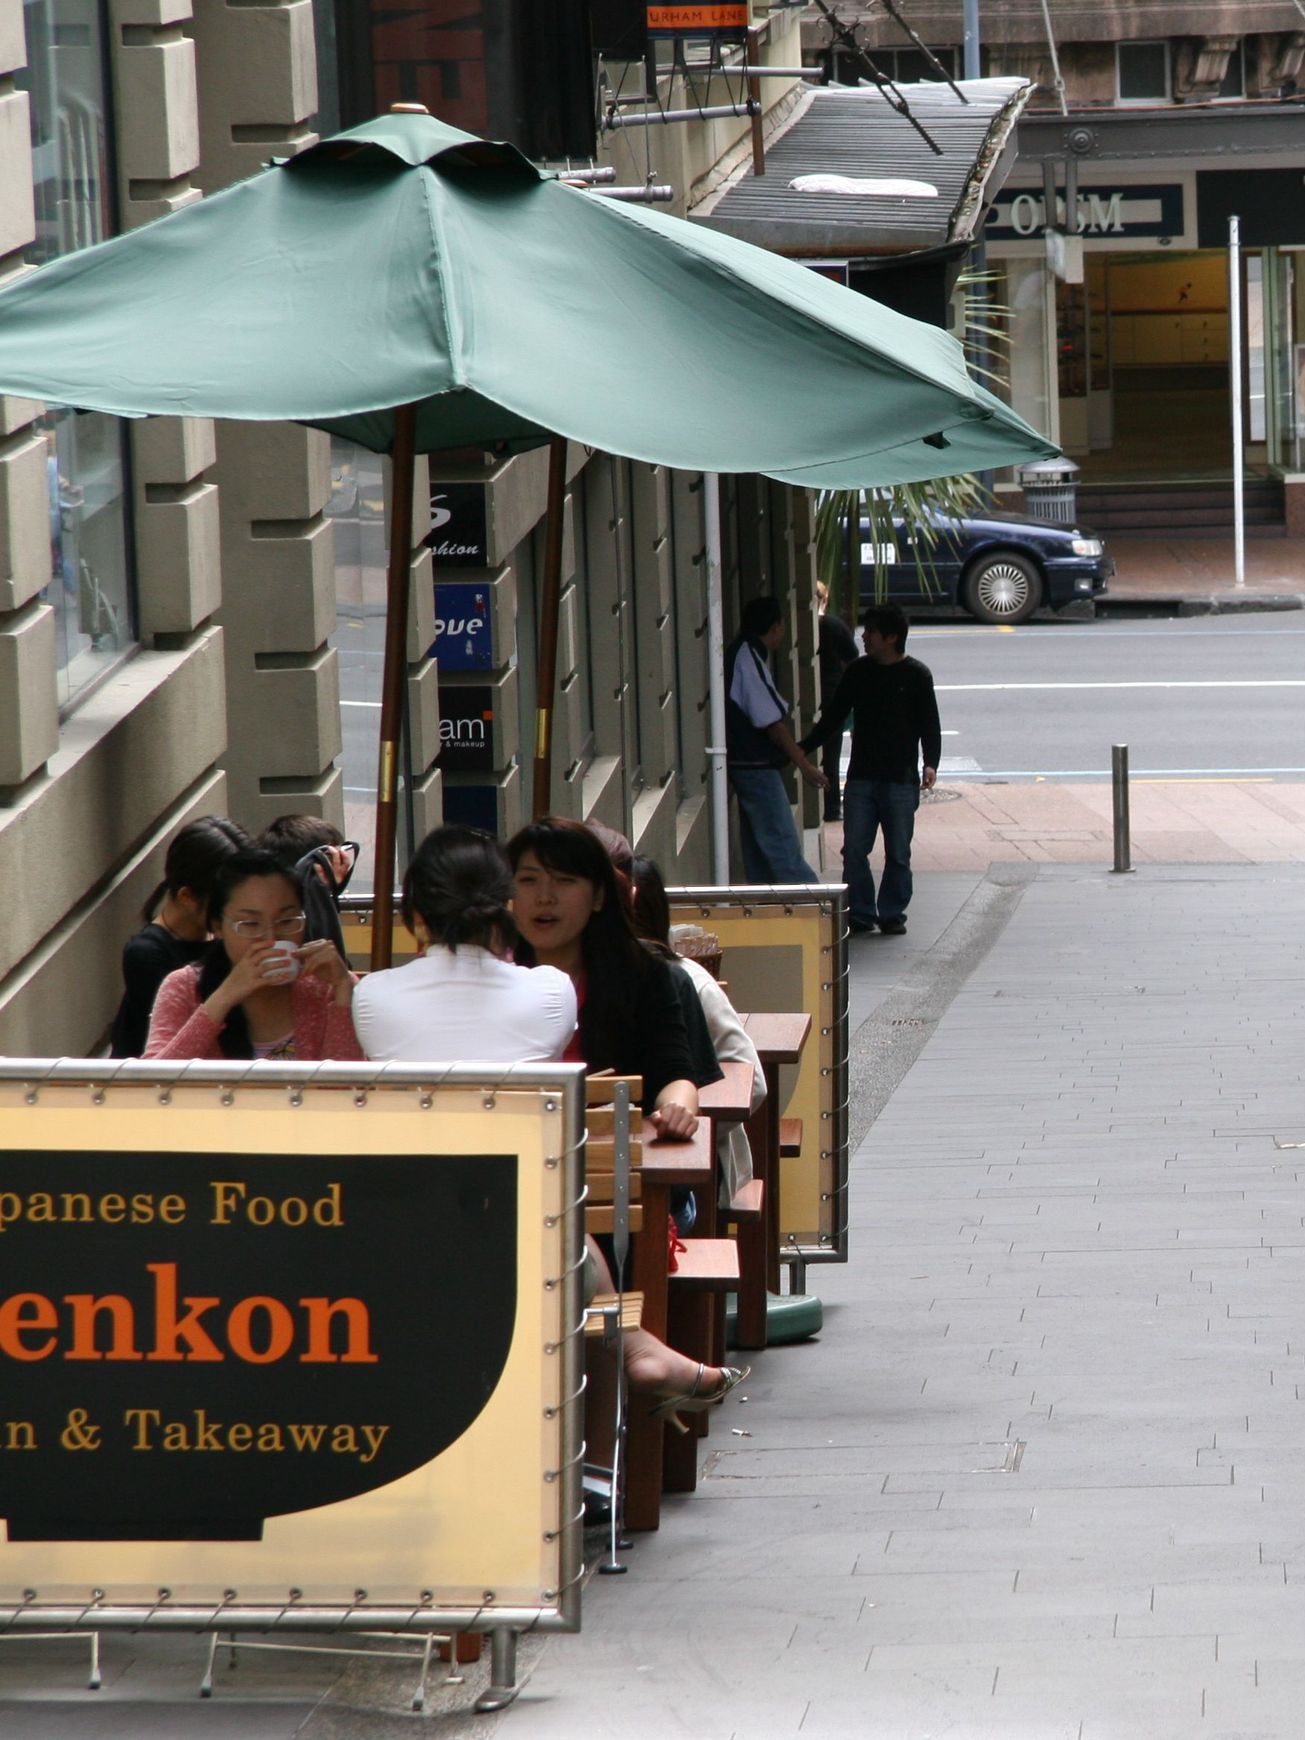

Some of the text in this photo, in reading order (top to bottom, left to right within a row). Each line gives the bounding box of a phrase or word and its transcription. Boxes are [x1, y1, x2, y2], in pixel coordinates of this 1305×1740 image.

[439, 718, 485, 740] am
[454, 741, 485, 749] makeup
[210, 1181, 344, 1227] Food
[0, 1263, 379, 1364] enkon
[61, 1407, 101, 1451] &
[124, 1409, 390, 1462] Takeaway
